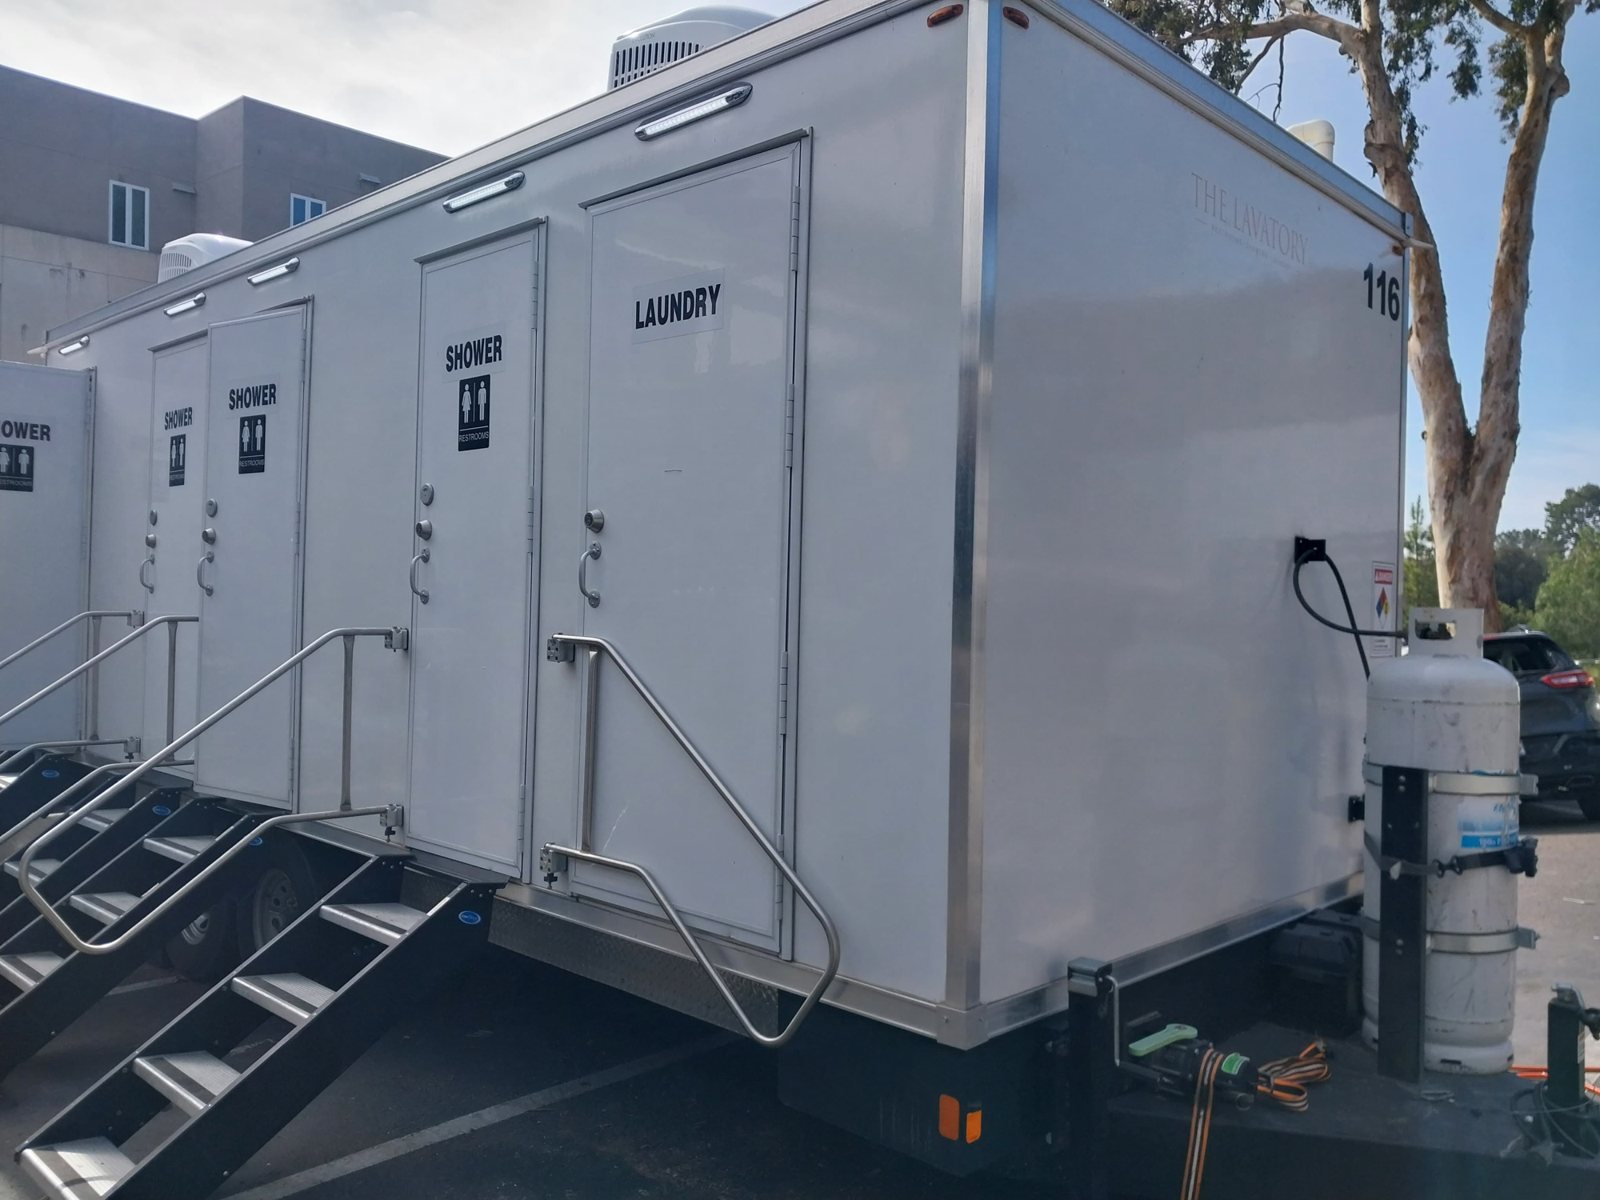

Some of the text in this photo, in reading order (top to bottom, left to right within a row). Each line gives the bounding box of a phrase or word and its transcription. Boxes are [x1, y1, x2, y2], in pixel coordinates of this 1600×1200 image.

[1191, 172, 1228, 223] THE
[1234, 196, 1309, 264] LAVATORY
[635, 283, 721, 329] LAUNDRY
[1363, 262, 1400, 321] 116
[446, 335, 502, 372] SHOWER
[229, 383, 277, 410] SHOWER
[1, 420, 51, 441] OWER
[164, 406, 192, 430] SHOWER
[459, 431, 489, 442] RESTROOMS
